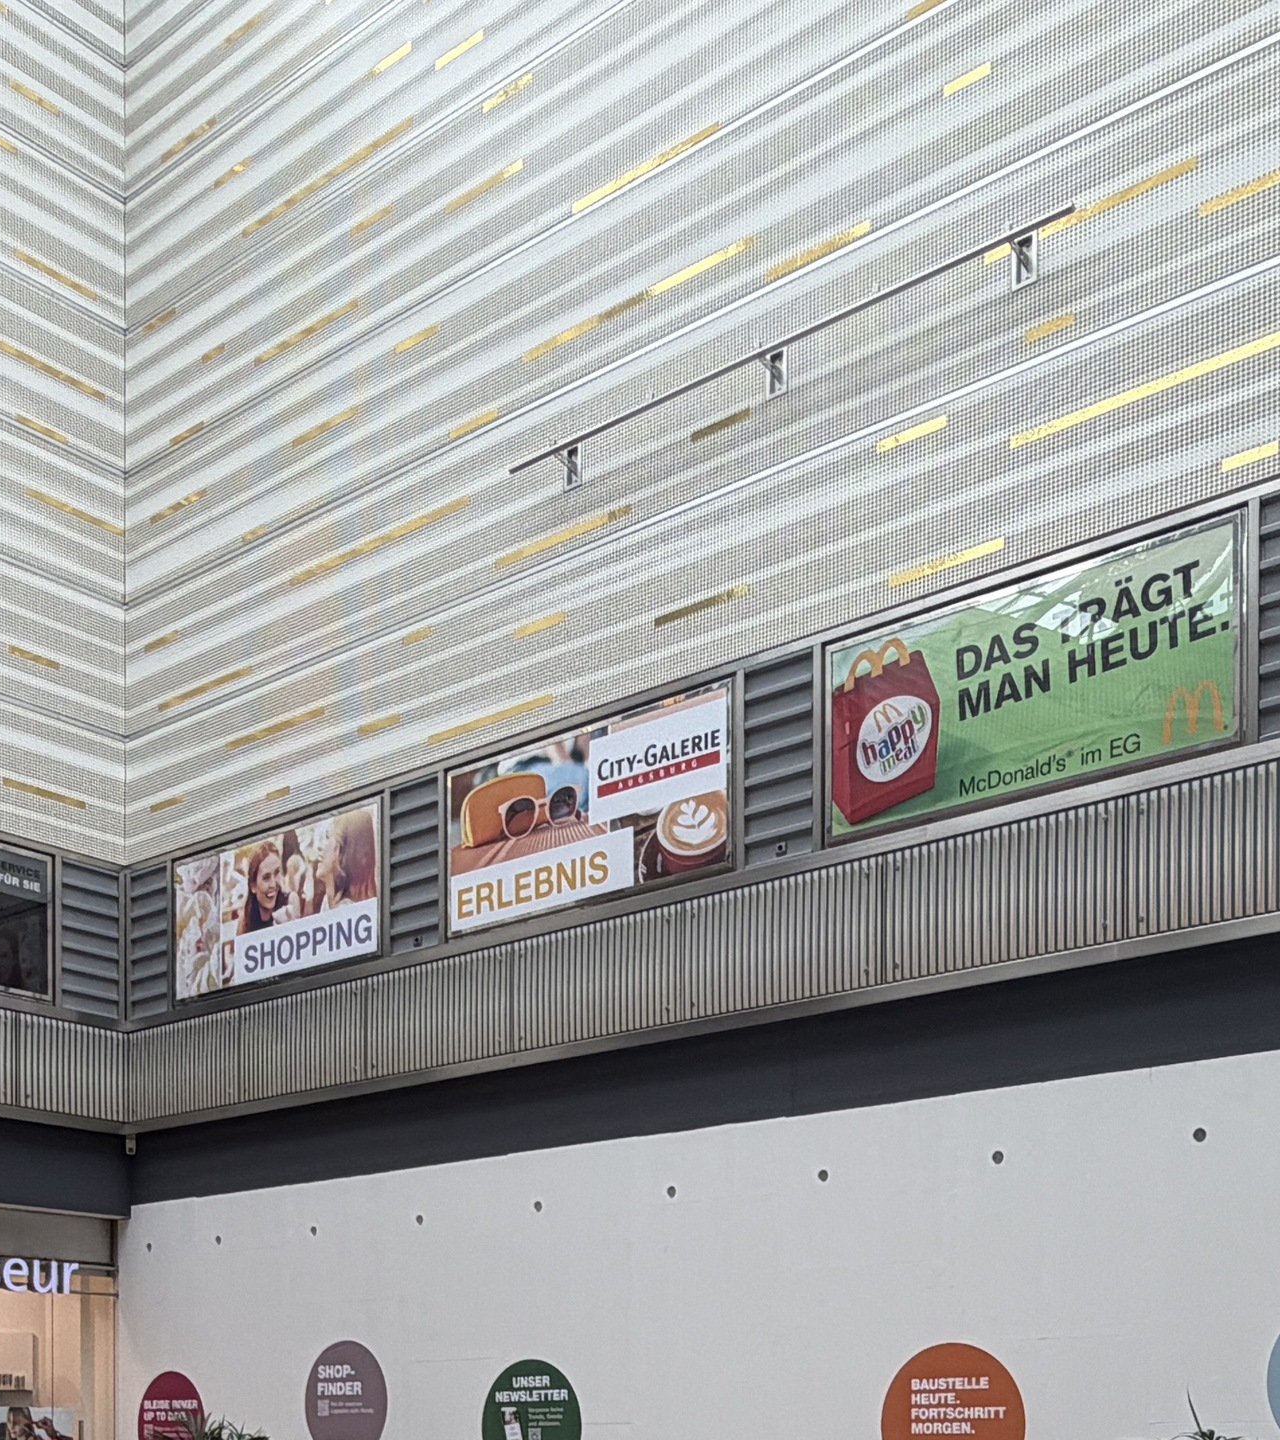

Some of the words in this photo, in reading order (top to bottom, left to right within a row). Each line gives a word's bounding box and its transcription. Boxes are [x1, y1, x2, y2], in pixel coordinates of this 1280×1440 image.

[955, 622, 1039, 681] DAS
[958, 657, 1051, 722] MAN
[1067, 601, 1230, 685] HEUTE.
[861, 704, 931, 767] happy
[1080, 746, 1102, 766] im
[1109, 733, 1141, 759] EG
[879, 743, 917, 775] meal
[617, 758, 698, 790] AUGSBURG
[22, 878, 41, 894] SIE
[457, 849, 610, 921] ERLEBNIS
[243, 913, 373, 974] SHOPPING
[317, 1364, 356, 1379] SHOP-
[317, 1381, 362, 1396] FINDER
[512, 1375, 551, 1388] UNSER
[910, 1376, 990, 1391] BAUSTELLE
[495, 1389, 569, 1403] NEWSLETTER
[910, 1392, 961, 1406] HEUTE.
[910, 1406, 1007, 1420] FORTSCHRITT
[910, 1421, 976, 1435] MORGEN.
